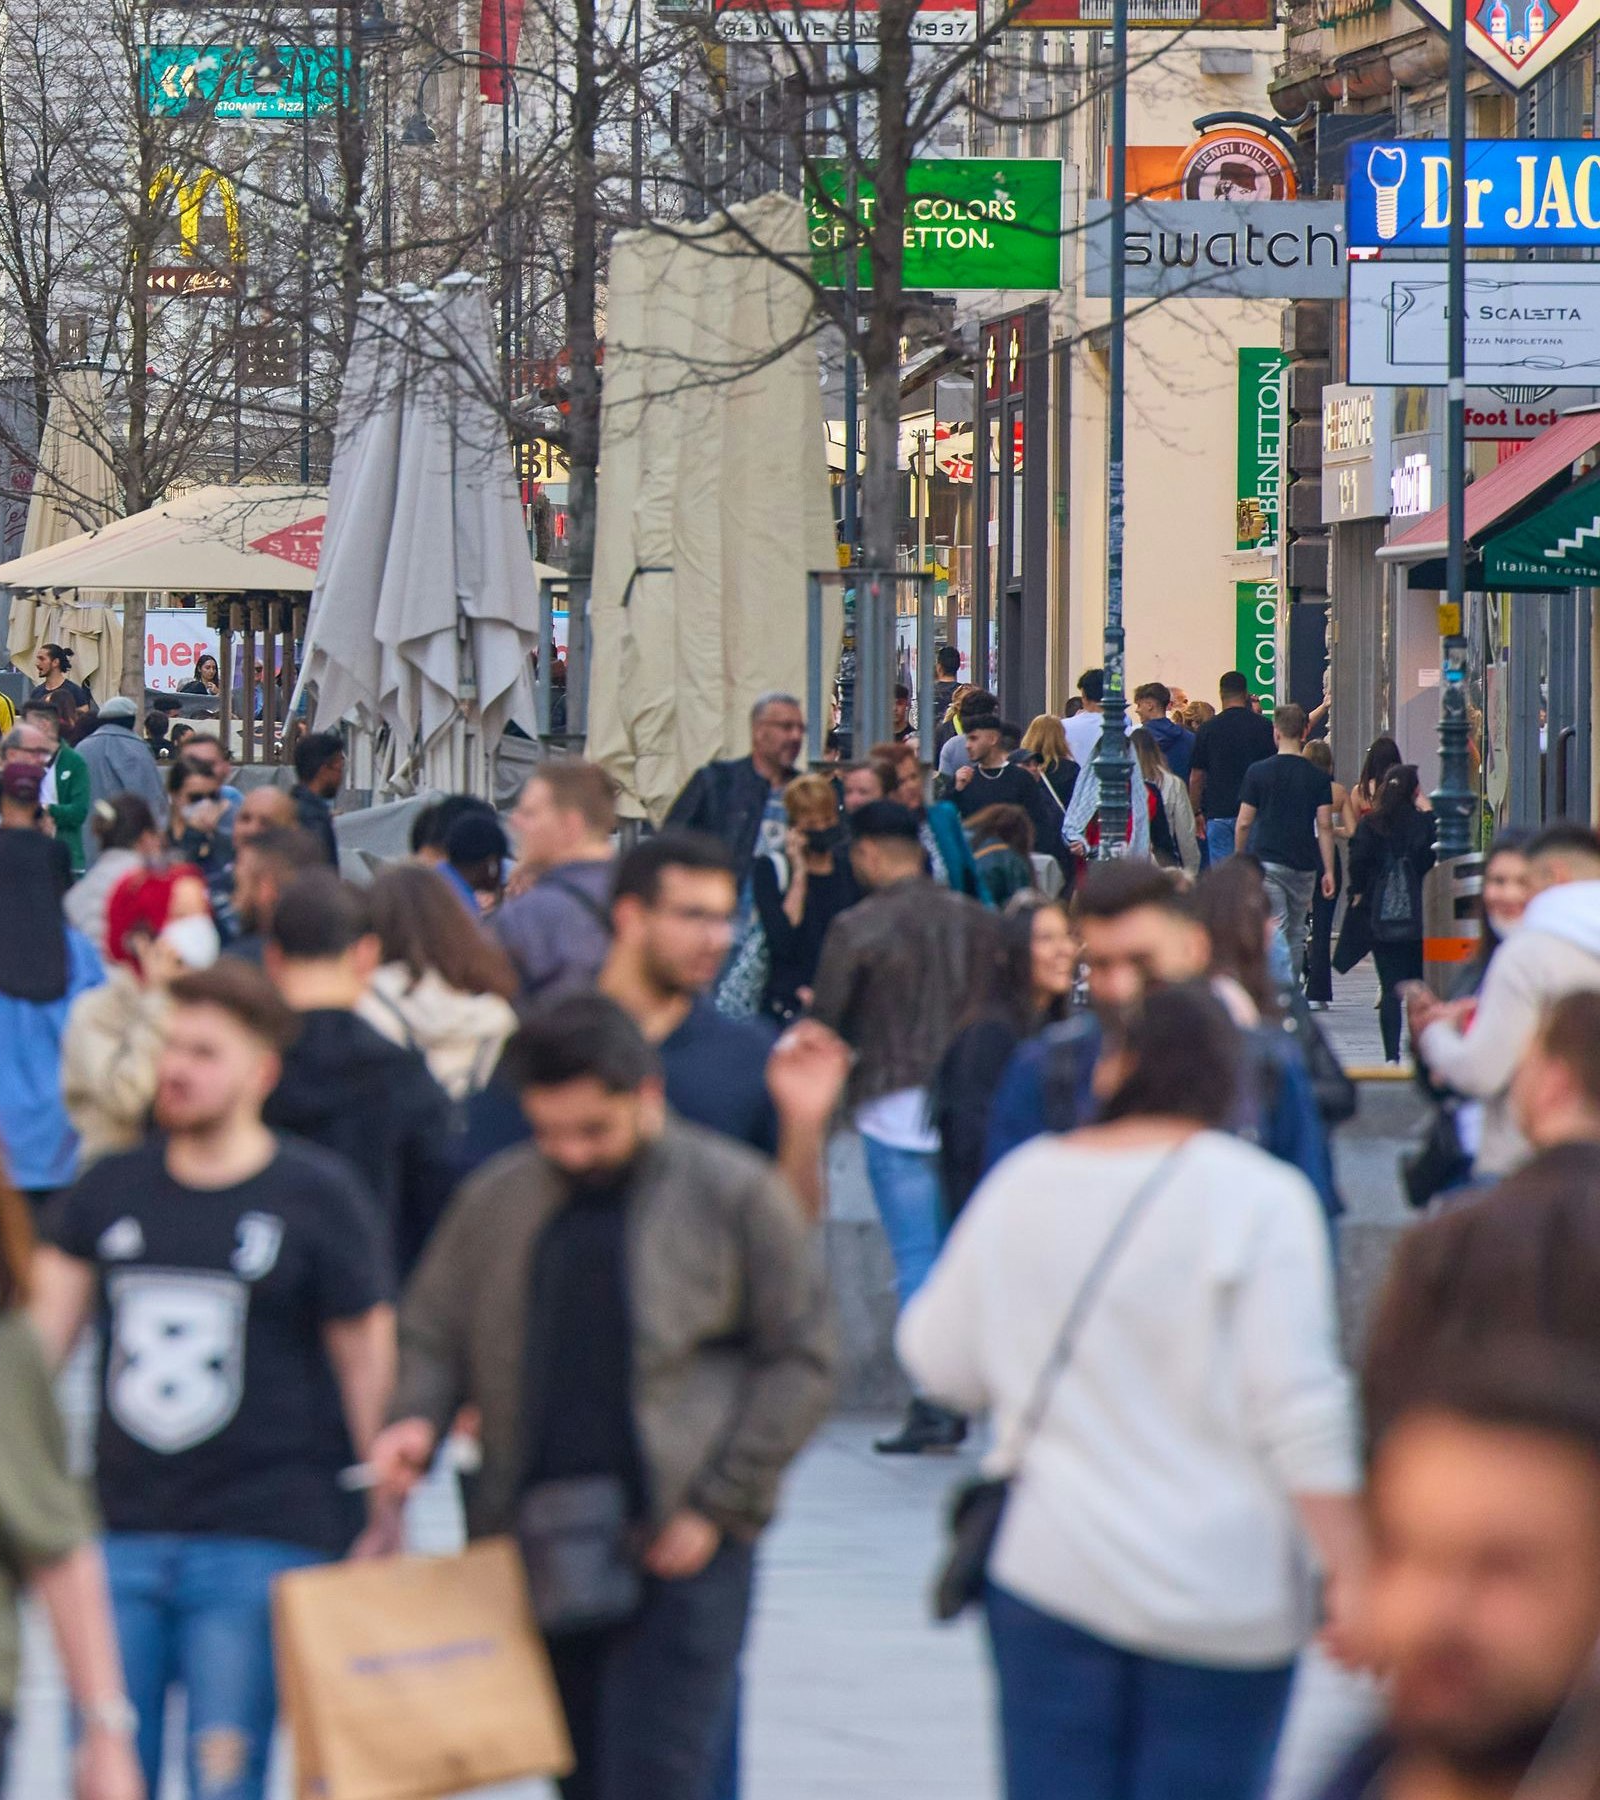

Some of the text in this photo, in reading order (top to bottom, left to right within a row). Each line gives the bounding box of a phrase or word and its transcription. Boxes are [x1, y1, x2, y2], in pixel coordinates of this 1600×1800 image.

[915, 22, 969, 37] 1937
[1196, 141, 1281, 177] HENRI WILLIG
[1420, 156, 1494, 229] Dr
[914, 199, 1017, 222] COLORS
[811, 226, 846, 247] OF
[1124, 224, 1338, 268] swatch
[1496, 560, 1548, 574] italian
